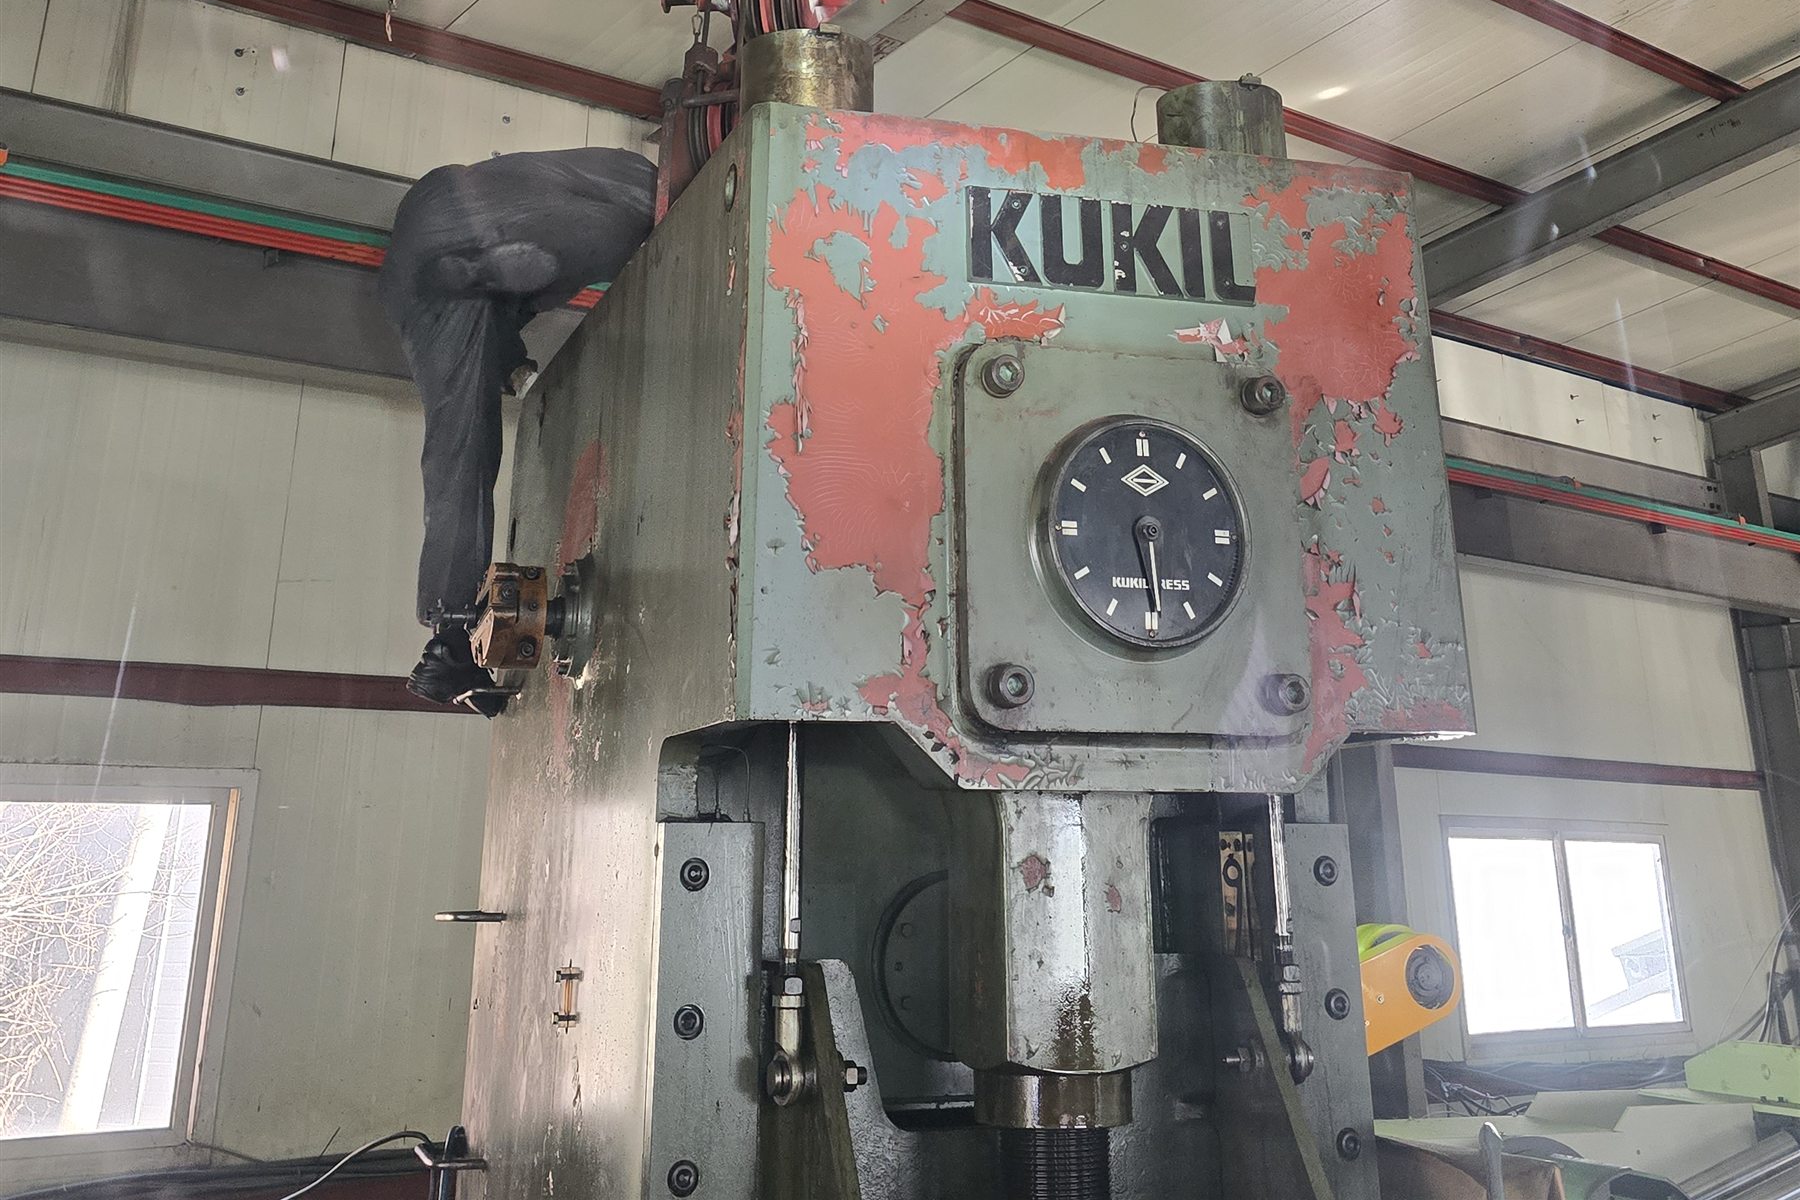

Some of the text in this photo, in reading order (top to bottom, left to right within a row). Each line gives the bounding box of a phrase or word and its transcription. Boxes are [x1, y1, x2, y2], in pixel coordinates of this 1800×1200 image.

[969, 186, 1256, 303] KUKIL
[1112, 576, 1190, 591] KUKIL RESS
